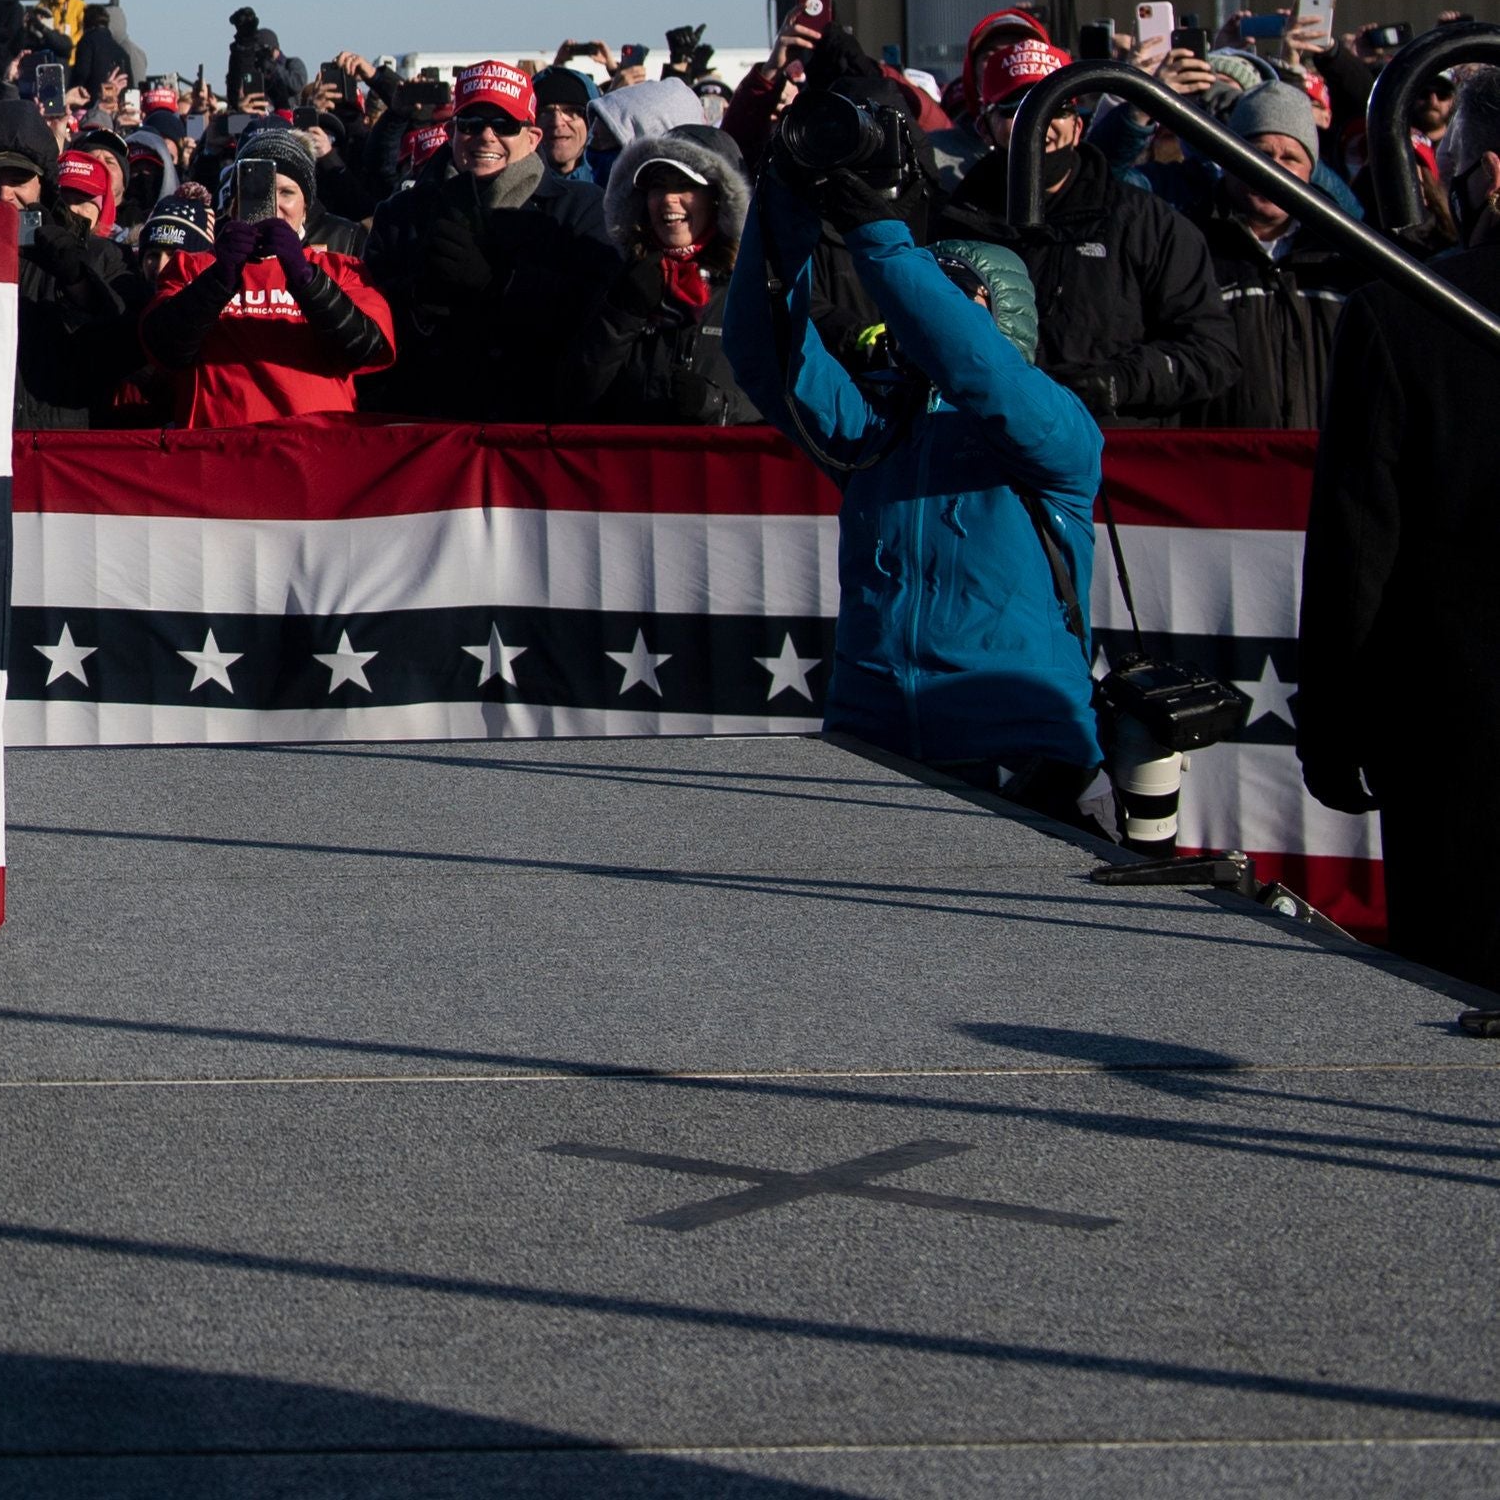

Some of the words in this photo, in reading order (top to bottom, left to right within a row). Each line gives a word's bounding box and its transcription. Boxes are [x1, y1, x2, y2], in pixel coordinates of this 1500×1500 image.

[1014, 39, 1049, 53] KEEP
[1001, 51, 1062, 69] AMERICA
[460, 66, 484, 81] MAKE
[484, 65, 527, 88] AMERICA
[463, 79, 491, 94] GREAT
[491, 81, 521, 99] AGAIN
[274, 307, 302, 317] GREAT
